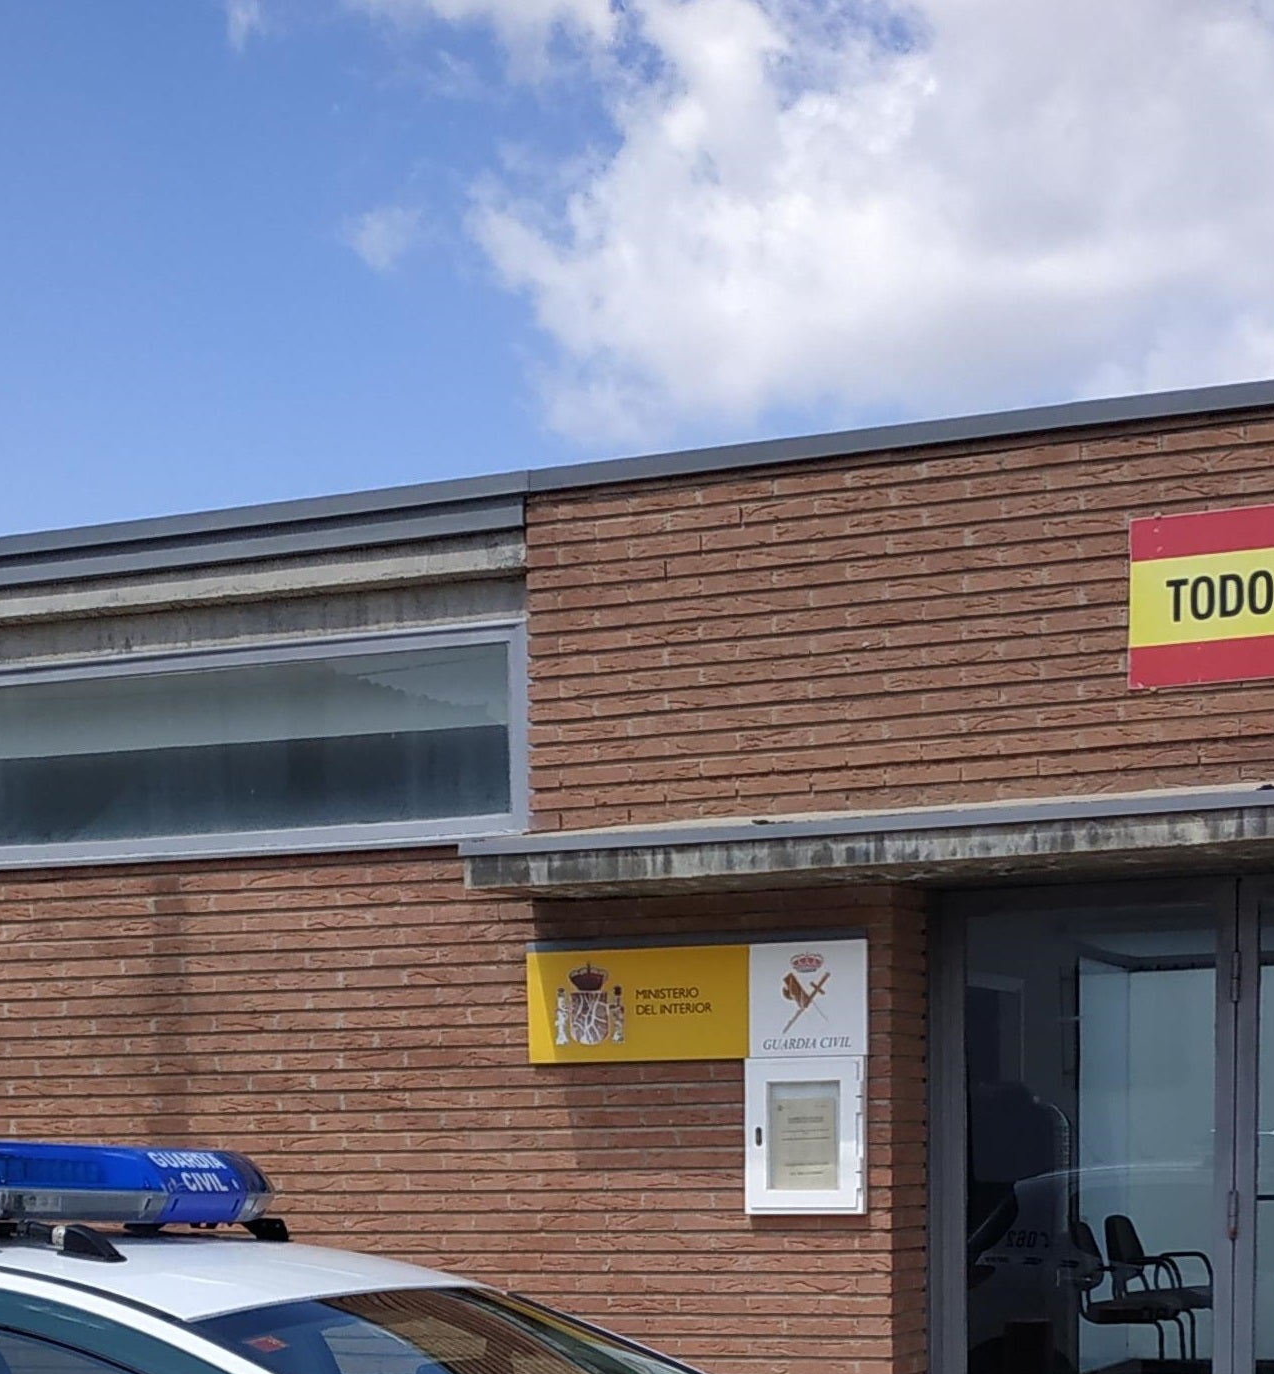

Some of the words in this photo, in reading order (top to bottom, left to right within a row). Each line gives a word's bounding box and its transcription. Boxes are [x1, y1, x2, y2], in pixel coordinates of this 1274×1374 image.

[1165, 568, 1274, 623] TODO
[635, 987, 699, 1000] MINISTERIO
[635, 1003, 658, 1016] DEL
[659, 1002, 712, 1015] INTERIOR
[762, 1037, 817, 1051] GUARDIA
[819, 1036, 852, 1049] CIVIL
[146, 1151, 228, 1170] GUARDIA
[180, 1171, 230, 1192] CIVIL
